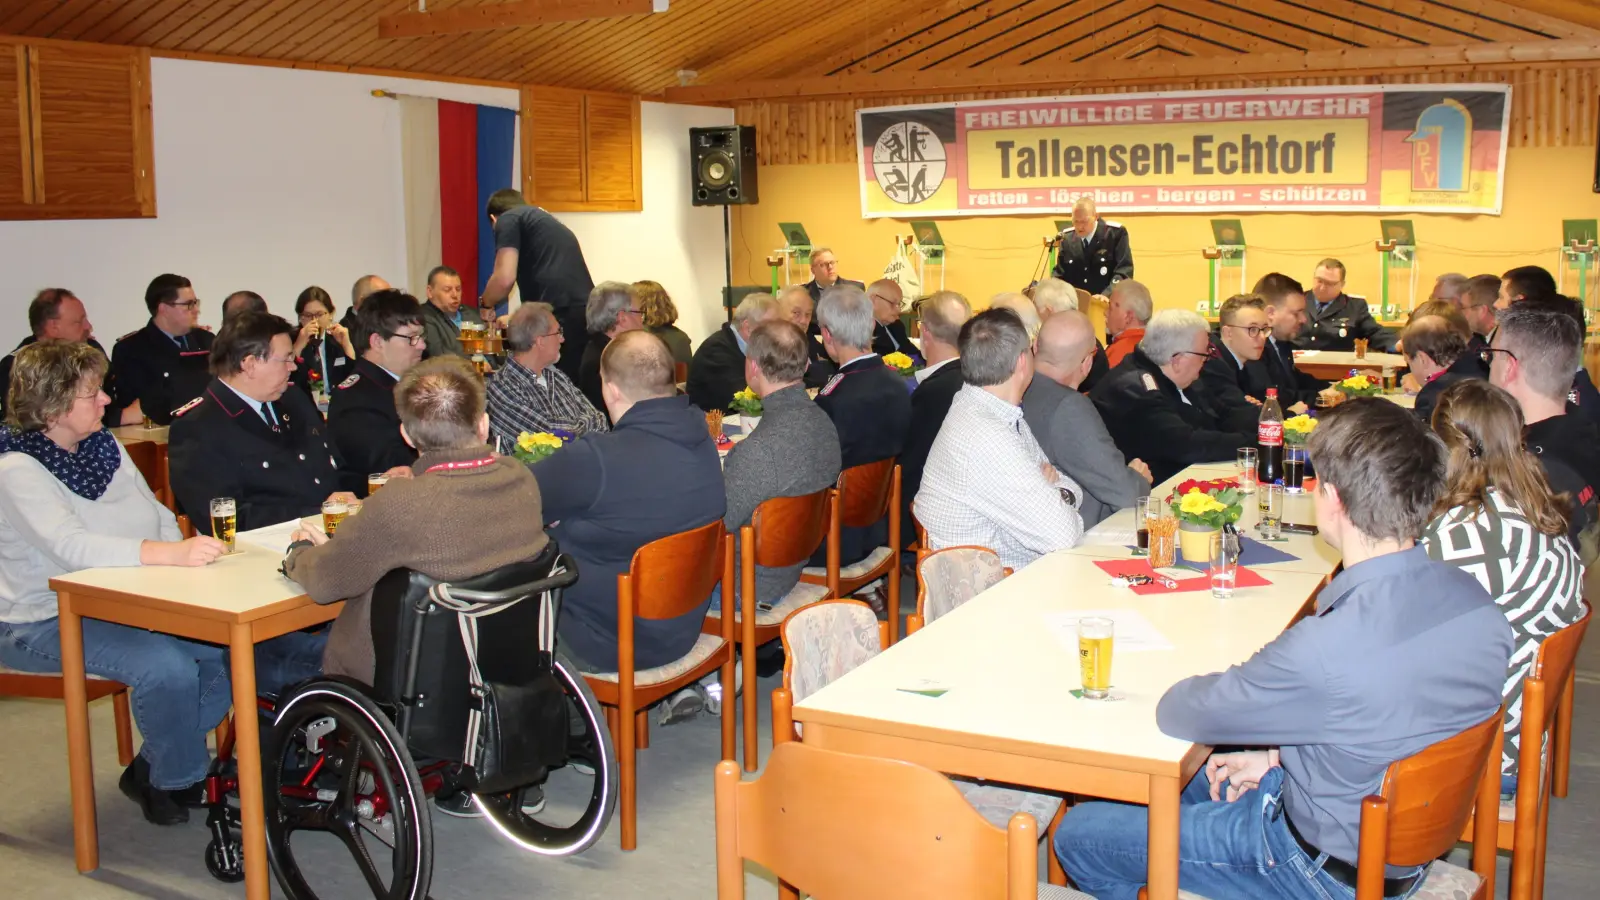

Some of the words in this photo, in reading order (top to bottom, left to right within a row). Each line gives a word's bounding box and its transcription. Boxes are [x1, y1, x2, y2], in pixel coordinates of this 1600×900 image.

[964, 104, 1153, 129] FREIWILLIGE
[1164, 98, 1371, 121] FEUERWEHR
[995, 132, 1337, 179] Tallensen-Echtorf
[968, 191, 1029, 206] retten
[1157, 187, 1236, 204] bergen
[1259, 187, 1367, 201] schützen
